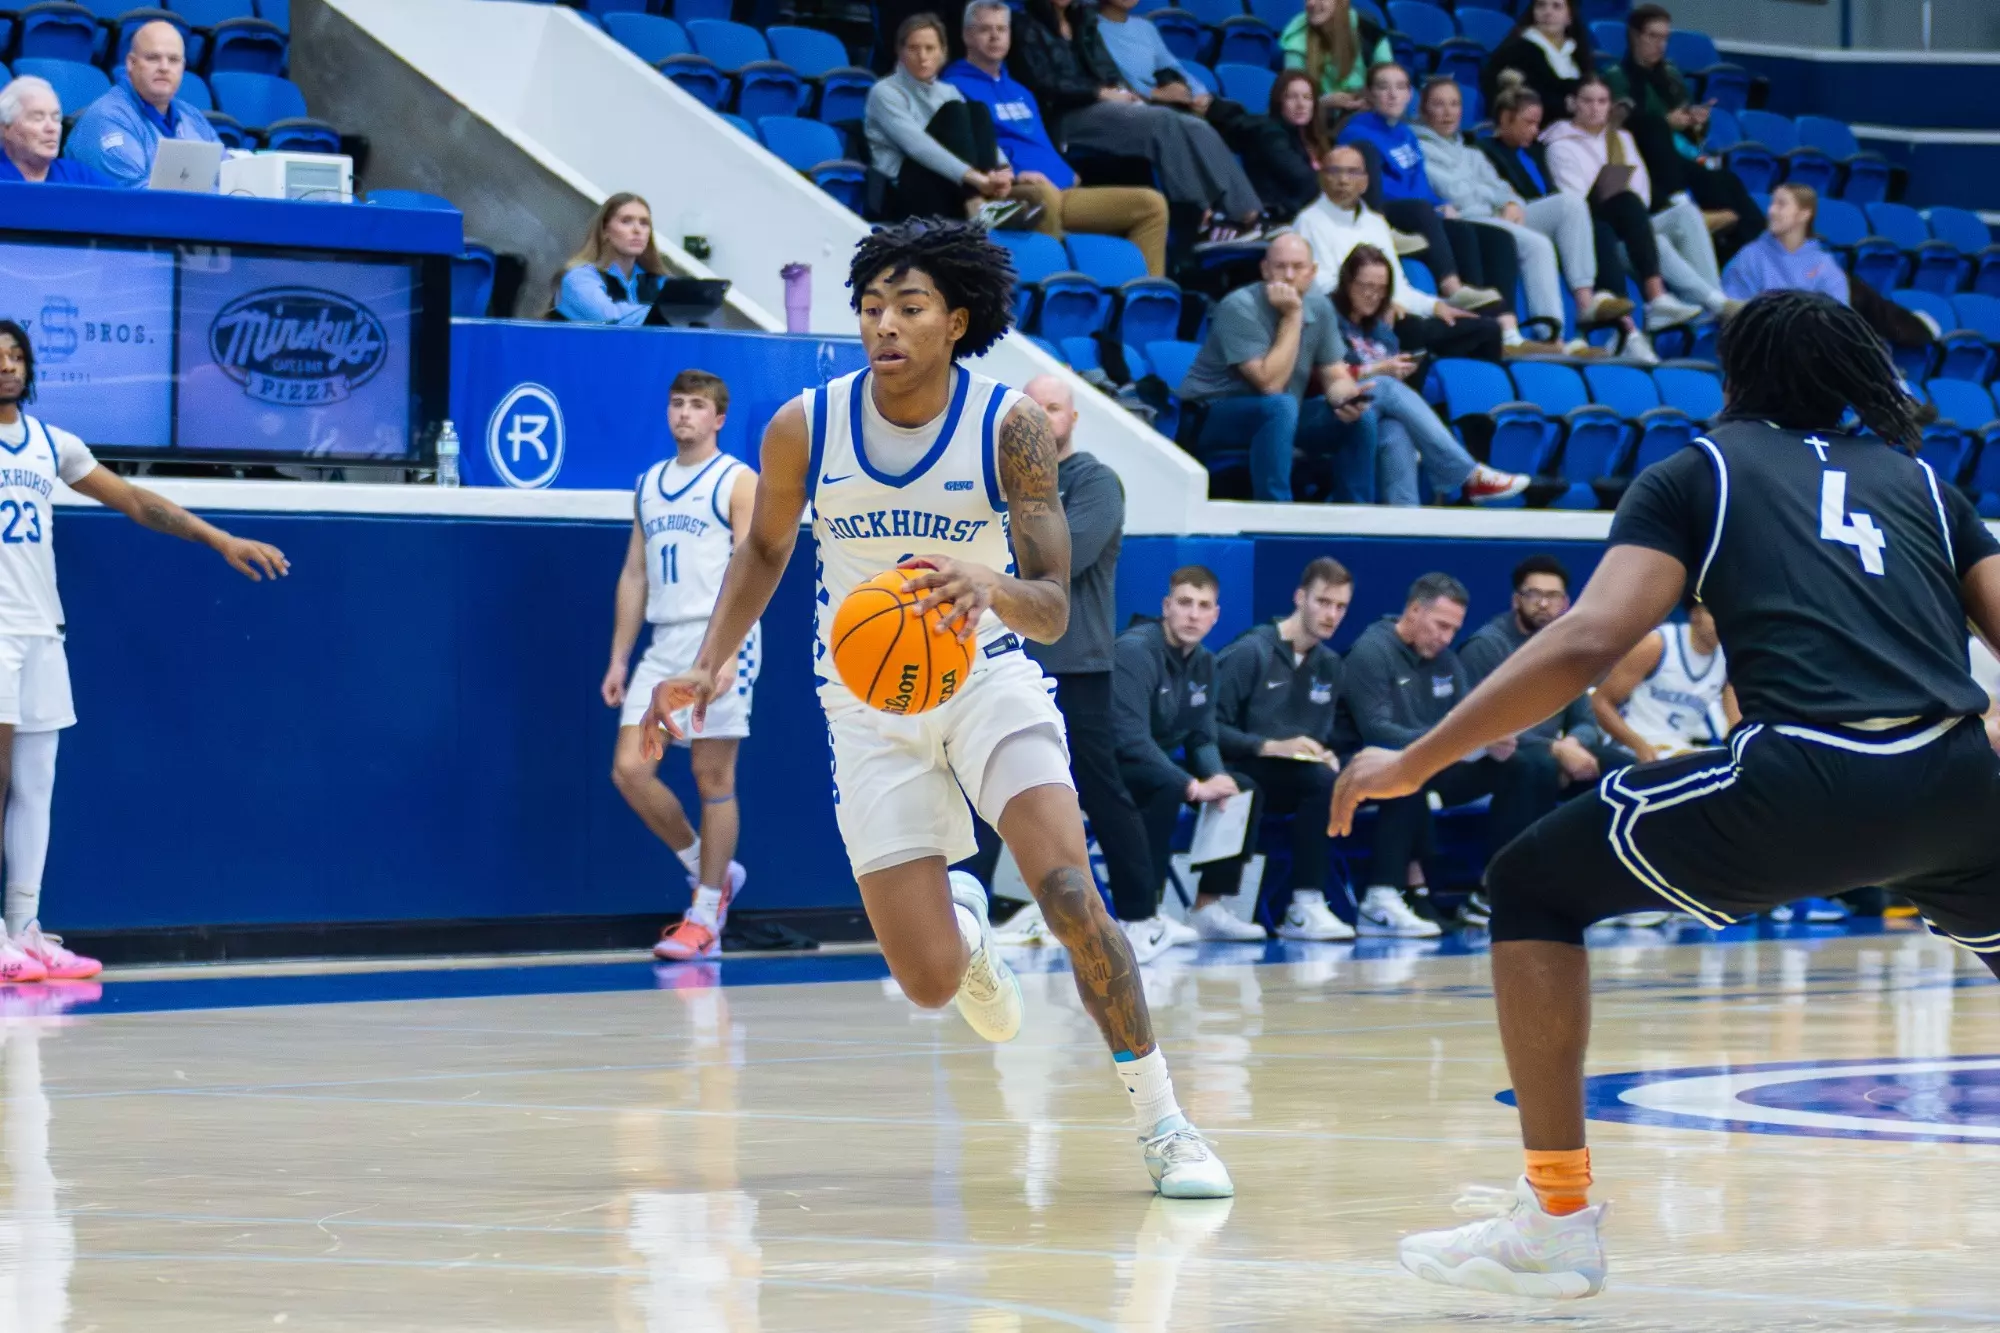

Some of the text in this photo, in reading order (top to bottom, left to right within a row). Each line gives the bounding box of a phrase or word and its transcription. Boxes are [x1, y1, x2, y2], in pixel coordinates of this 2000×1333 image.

[84, 321, 154, 344] BROS.
[216, 303, 380, 372] Minsky's
[259, 378, 338, 400] PIZZA
[0, 468, 53, 500] KHURST
[0, 499, 41, 544] 23
[645, 514, 709, 541] OCKHURST
[824, 509, 989, 543] ROCKHURST
[1820, 469, 1887, 576] 4
[661, 543, 679, 585] 11
[935, 668, 957, 707] CAA
